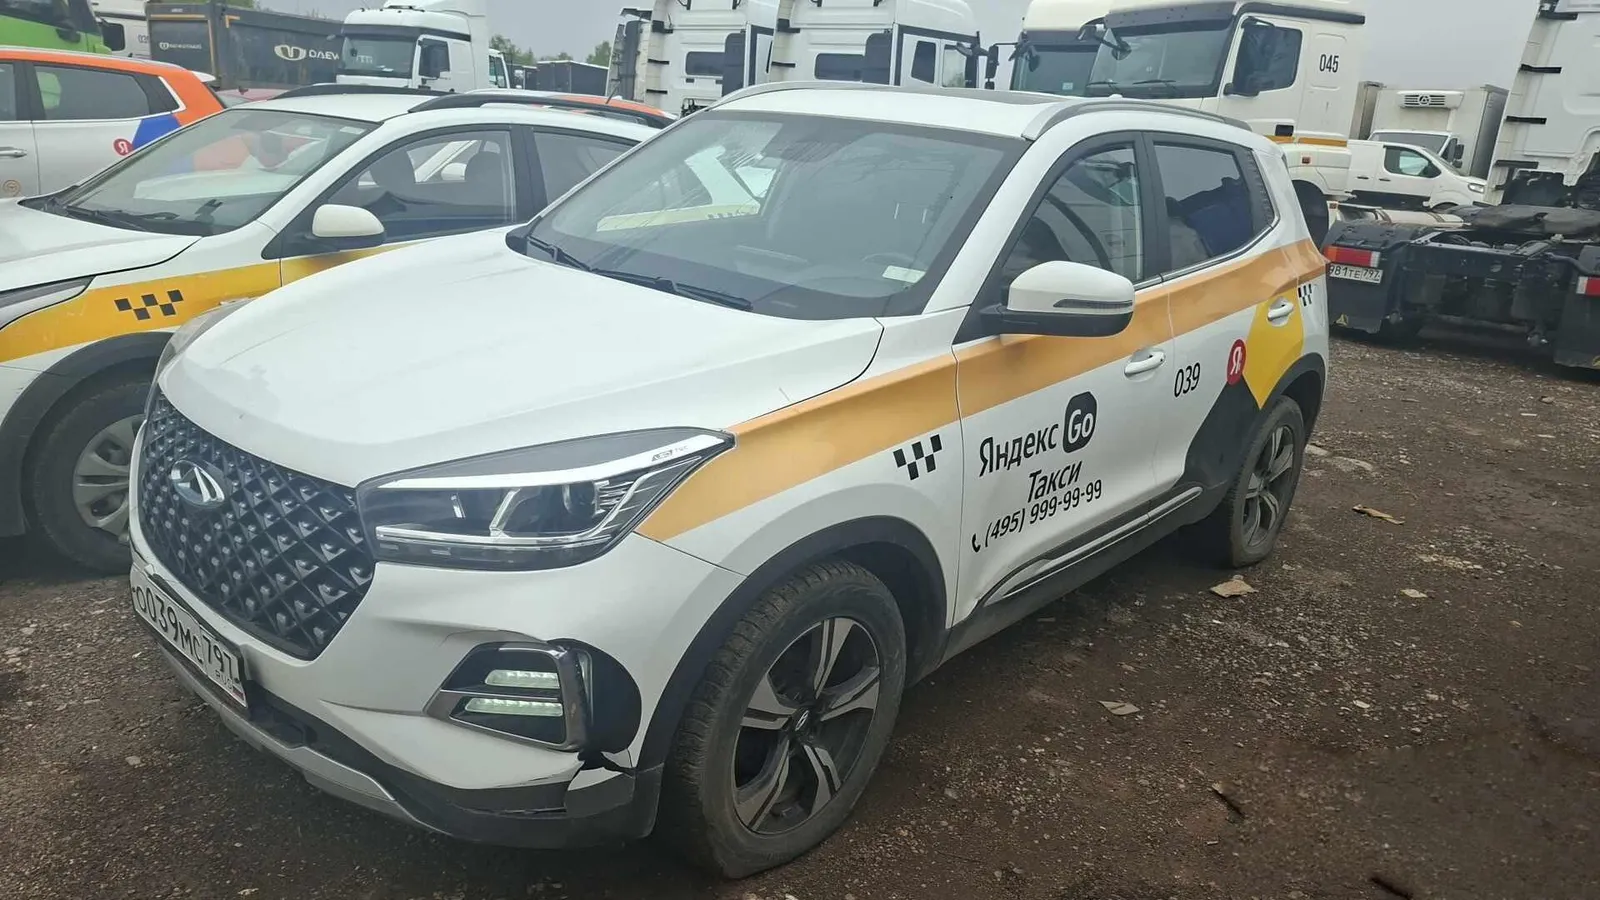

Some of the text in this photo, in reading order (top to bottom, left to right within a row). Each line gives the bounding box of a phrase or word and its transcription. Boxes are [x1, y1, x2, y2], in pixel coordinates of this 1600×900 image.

[1319, 54, 1339, 73] 045
[118, 141, 128, 153] Я
[1230, 346, 1242, 375] Я
[1174, 362, 1200, 397] 039
[979, 408, 1094, 476] Яндекс Go
[1027, 460, 1082, 502] Такси
[984, 479, 1102, 547] (495) 999-99-99
